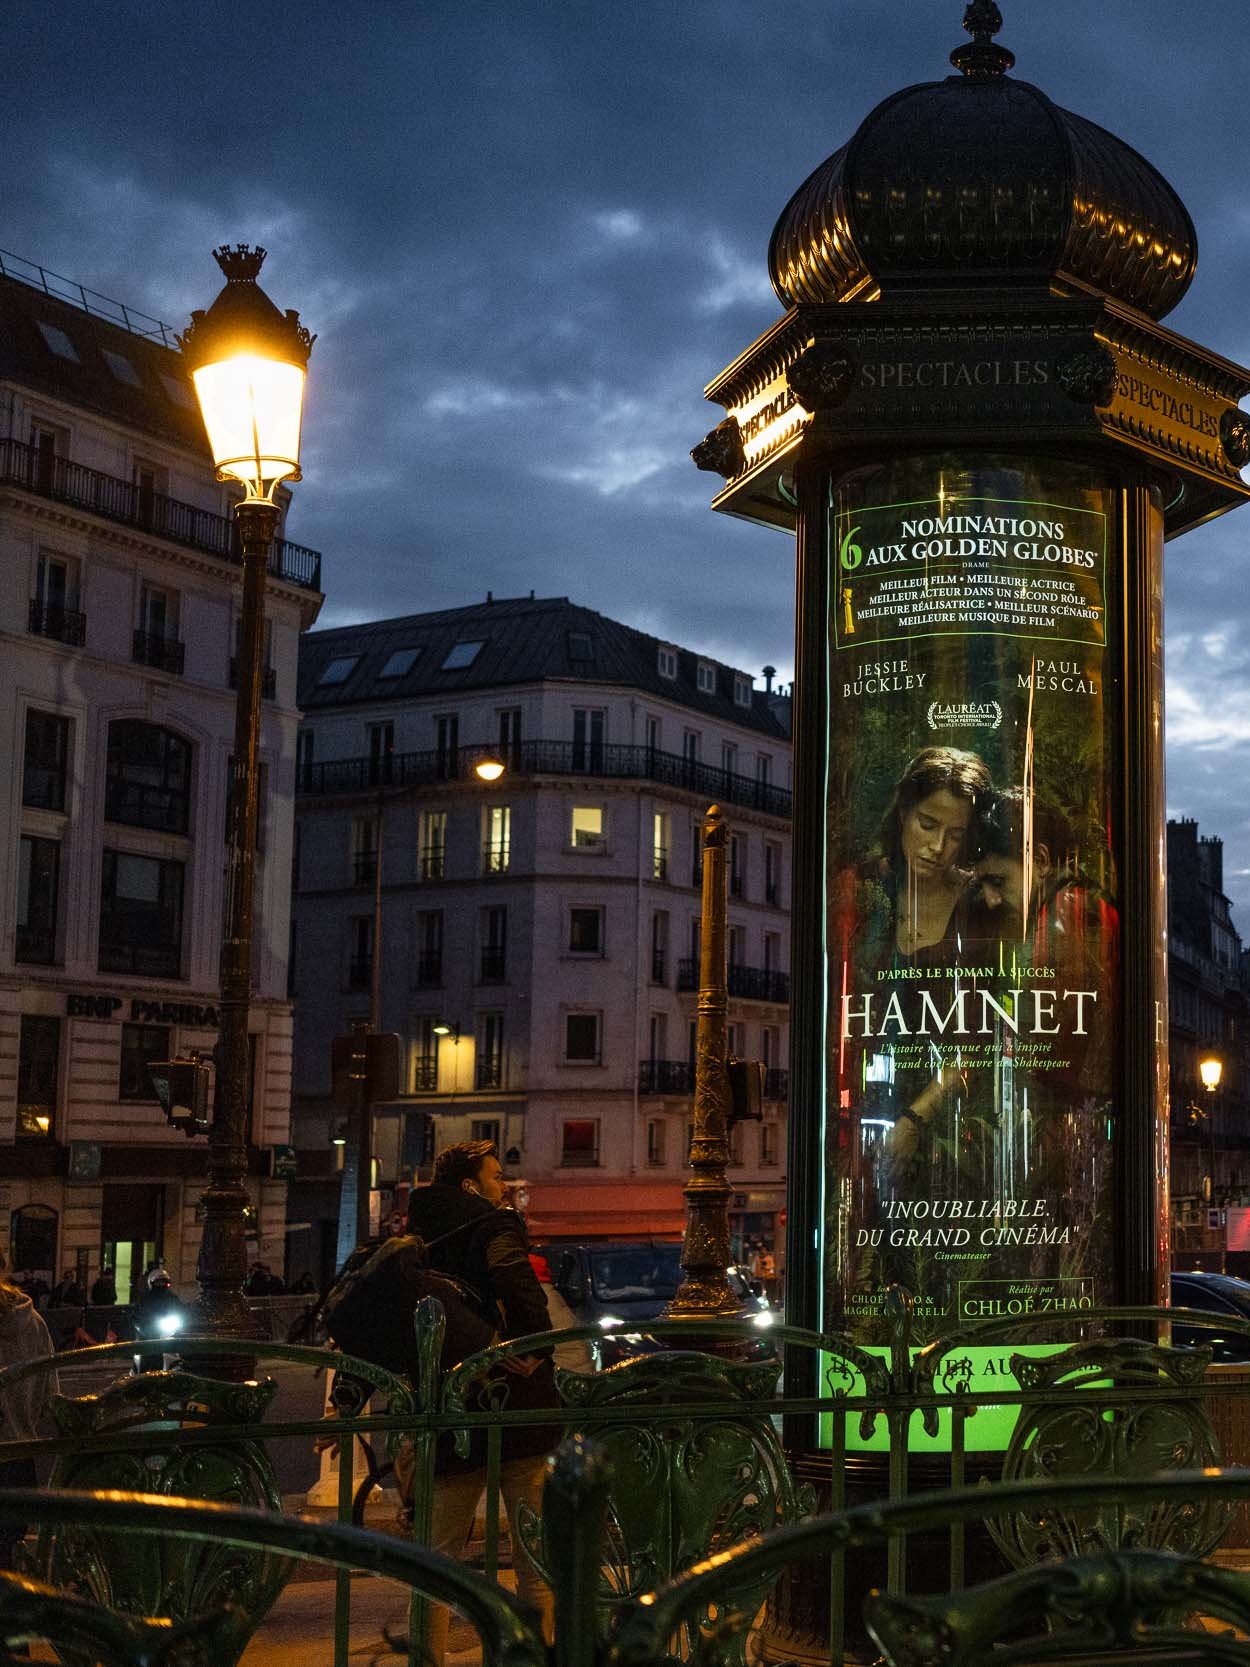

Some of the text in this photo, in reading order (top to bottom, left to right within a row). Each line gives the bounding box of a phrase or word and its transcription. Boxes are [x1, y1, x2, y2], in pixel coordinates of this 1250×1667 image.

[861, 359, 1050, 388] SPECTACLES
[1119, 372, 1219, 437] SPECTACLES
[901, 516, 1064, 540] NOMINATIONS
[840, 526, 862, 570] 6
[865, 543, 908, 566] AUX
[911, 539, 1008, 560] GOLDEN
[880, 574, 1076, 591] MEILLEUR FILM MEILLEURE ACTRICE
[869, 587, 1087, 606] MEILLEUR ACTEUR DANS UN SECOND RÔLE
[857, 600, 1100, 620] MEILLEURE RÉALISATRICE MEILLEUR SCÉNARIO
[898, 612, 1055, 627] MEILLEURE MUSIQUE DE FILM
[857, 660, 908, 680] JESSIE
[1036, 659, 1081, 675] PAUL
[843, 673, 926, 698] BUCKLEY
[1017, 673, 1098, 695] MESCAL
[877, 966, 922, 980] D'APRÈS
[926, 968, 942, 978] LE
[945, 967, 994, 978] ROMAN
[1010, 966, 1055, 978] SUCCÈS
[66, 993, 222, 1025] BNP PARIBA
[841, 987, 1098, 1038] HAMNET
[880, 1042, 924, 1054] L'histoire
[927, 1042, 980, 1052] méconnue
[984, 1042, 1003, 1055] qui
[1018, 1041, 1052, 1055] inspiré
[1013, 1057, 1071, 1071] Shakespeare
[881, 1199, 1050, 1219] "INOUBLIABLE.
[856, 1223, 1079, 1247] DU GRAND CINÉMA"
[934, 1251, 992, 1261] Cinemateaser
[851, 1293, 884, 1304] CHLOÉ
[925, 1295, 935, 1304] &
[1008, 1284, 1055, 1296] Réalisé par
[843, 1306, 880, 1316] MAGGIE
[964, 1295, 1035, 1316] CHLOÉ
[1041, 1296, 1092, 1312] ZHAO
